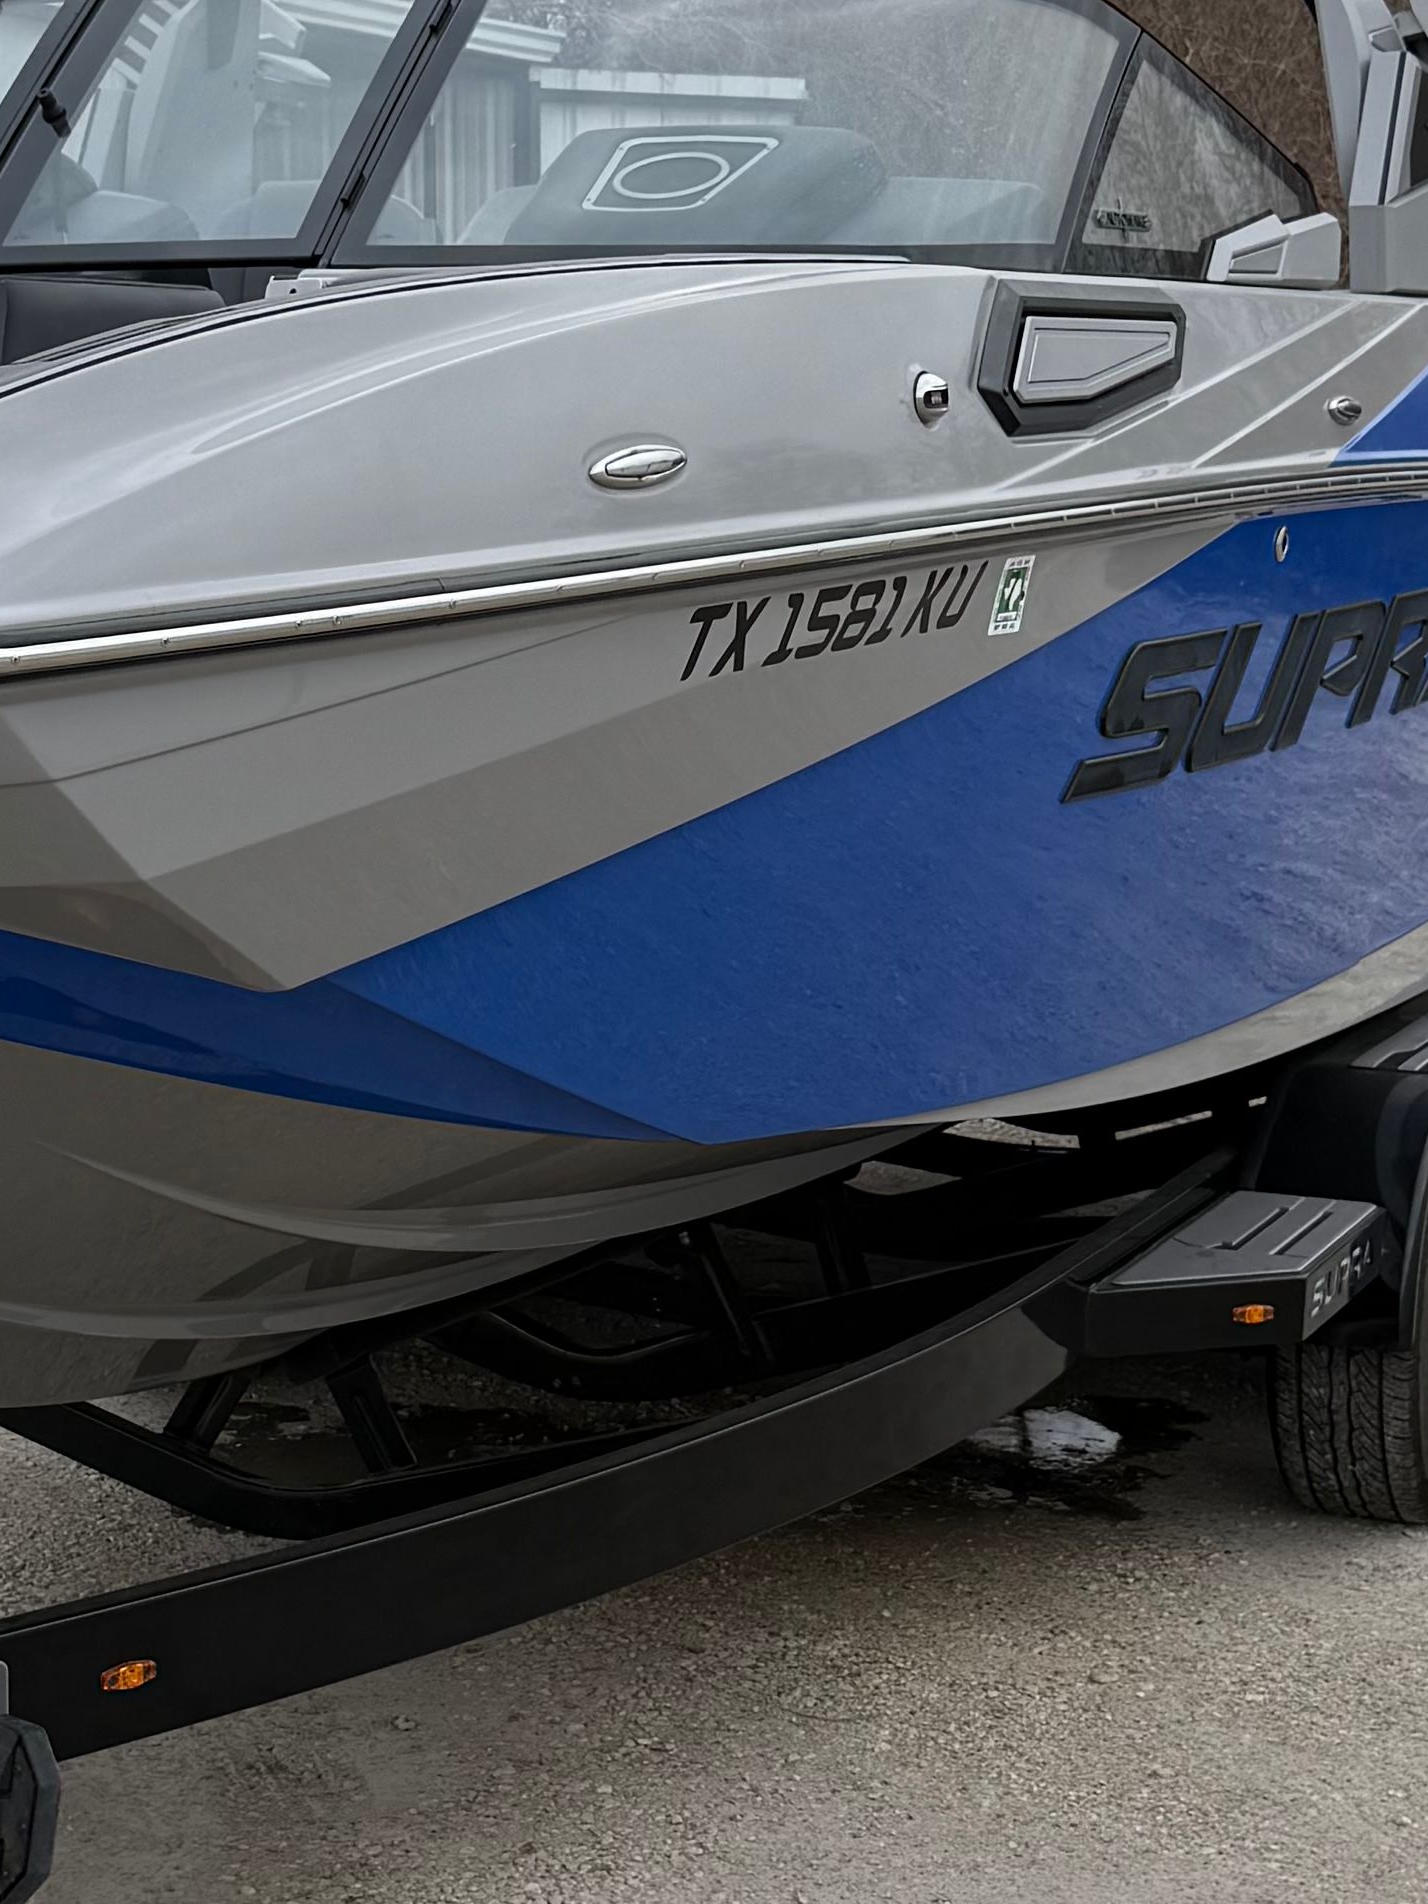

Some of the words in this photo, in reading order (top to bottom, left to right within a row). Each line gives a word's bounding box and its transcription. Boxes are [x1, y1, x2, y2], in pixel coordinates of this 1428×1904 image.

[680, 596, 771, 682] TX
[760, 576, 908, 667] 1581
[900, 560, 989, 638] KU
[1310, 1239, 1371, 1317] SUPRA
